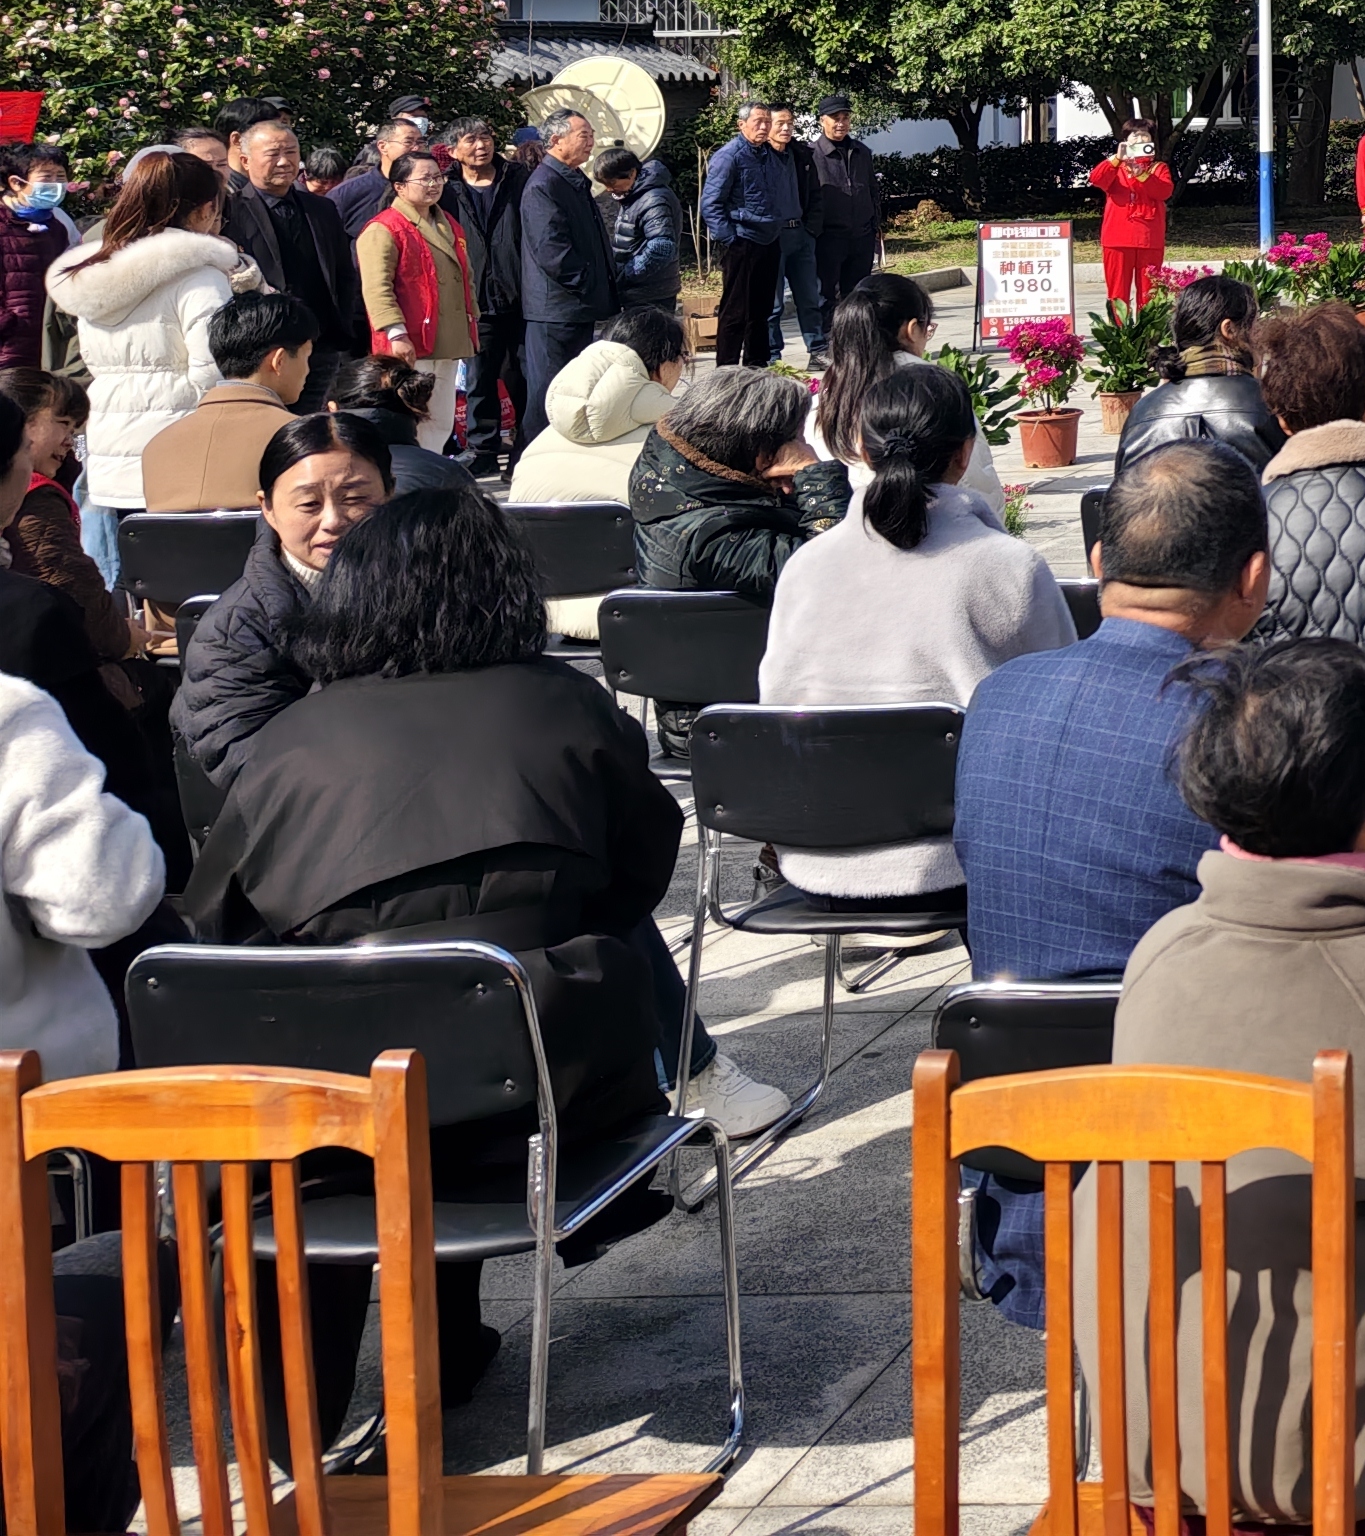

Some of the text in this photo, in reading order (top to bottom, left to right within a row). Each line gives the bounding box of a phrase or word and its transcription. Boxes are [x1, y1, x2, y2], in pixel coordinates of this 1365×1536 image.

[999, 260, 1053, 276] 种植牙
[1000, 278, 1052, 293] 1980
